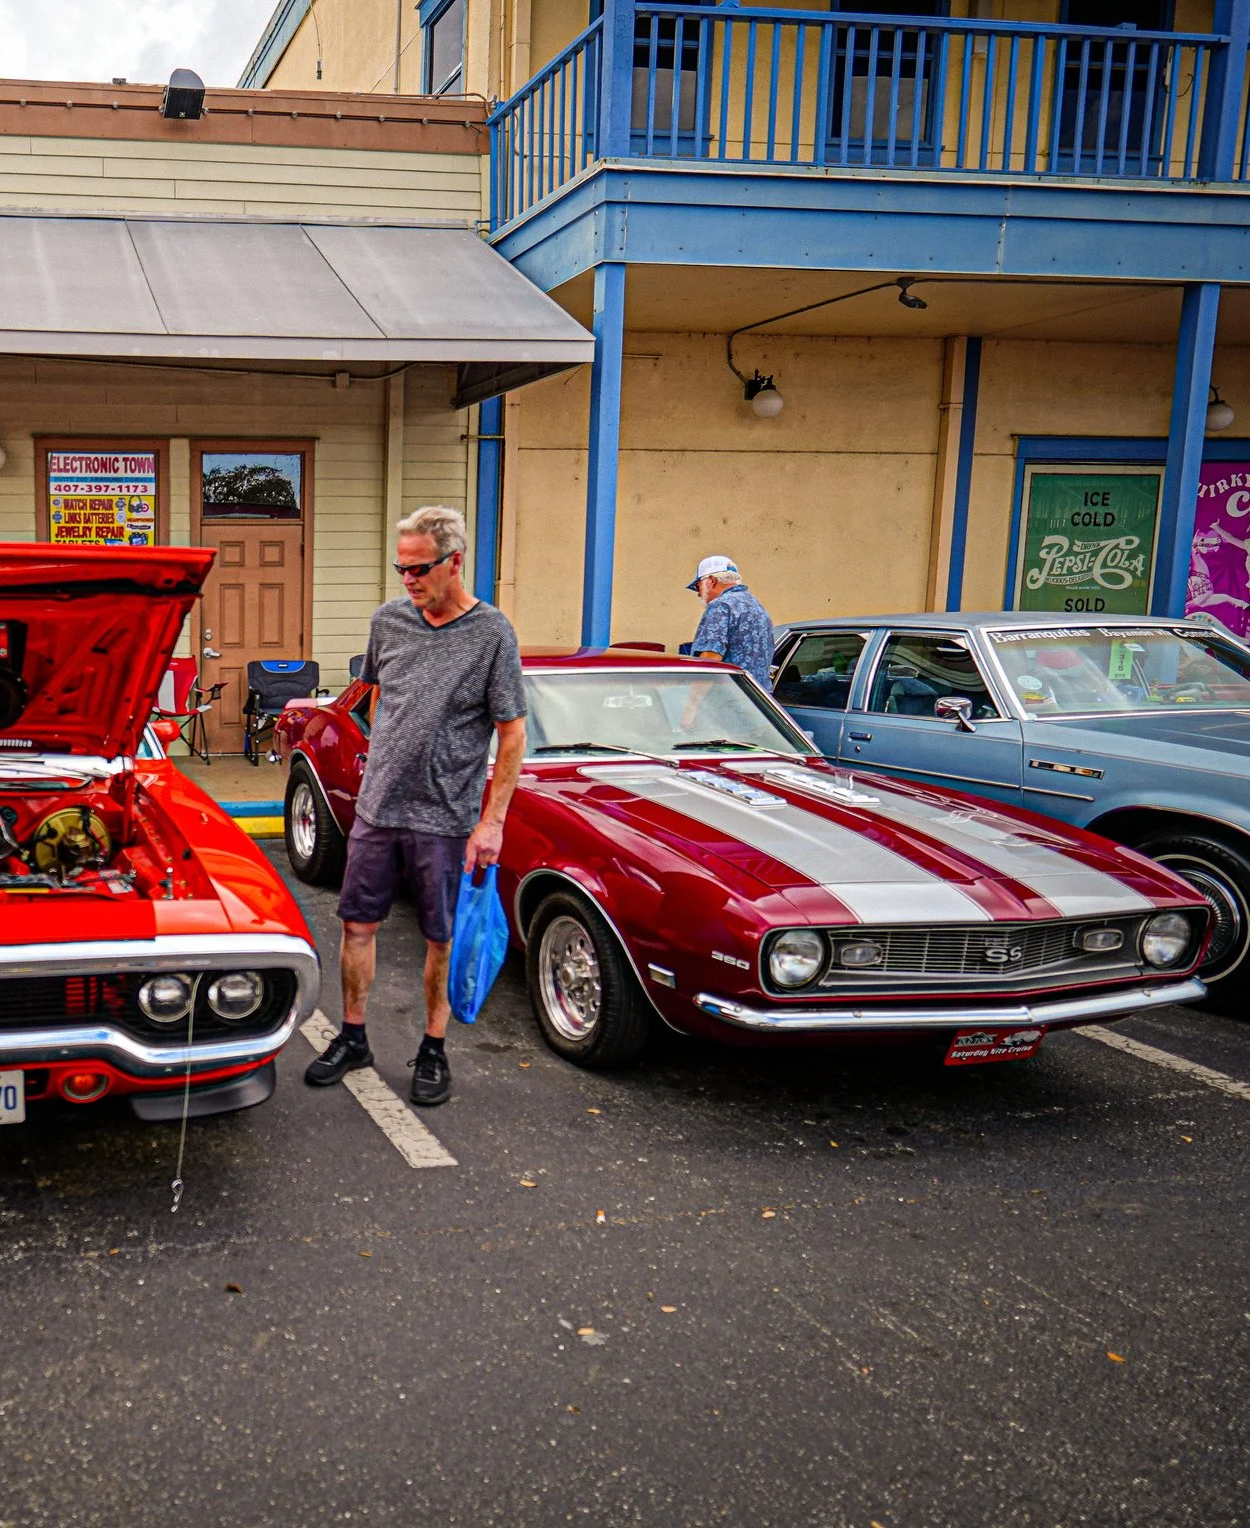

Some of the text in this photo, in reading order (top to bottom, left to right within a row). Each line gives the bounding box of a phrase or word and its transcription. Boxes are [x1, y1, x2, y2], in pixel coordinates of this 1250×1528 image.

[50, 456, 155, 474] ELECTRONIC TOWN
[54, 484, 148, 493] 407-397-1173
[63, 499, 114, 511] WATCH REPAIR
[1084, 491, 1111, 507] ICE
[64, 512, 115, 524] LINKS BATTERIES
[1070, 512, 1116, 528] COLD
[55, 526, 125, 539] JEWELRY REPAIR
[1064, 598, 1105, 613] SOLD
[988, 628, 1091, 644] Barranquitas
[985, 946, 1022, 963] SS
[958, 1038, 974, 1046] OLD
[951, 1045, 1033, 1059] Saturday Nite Cruise
